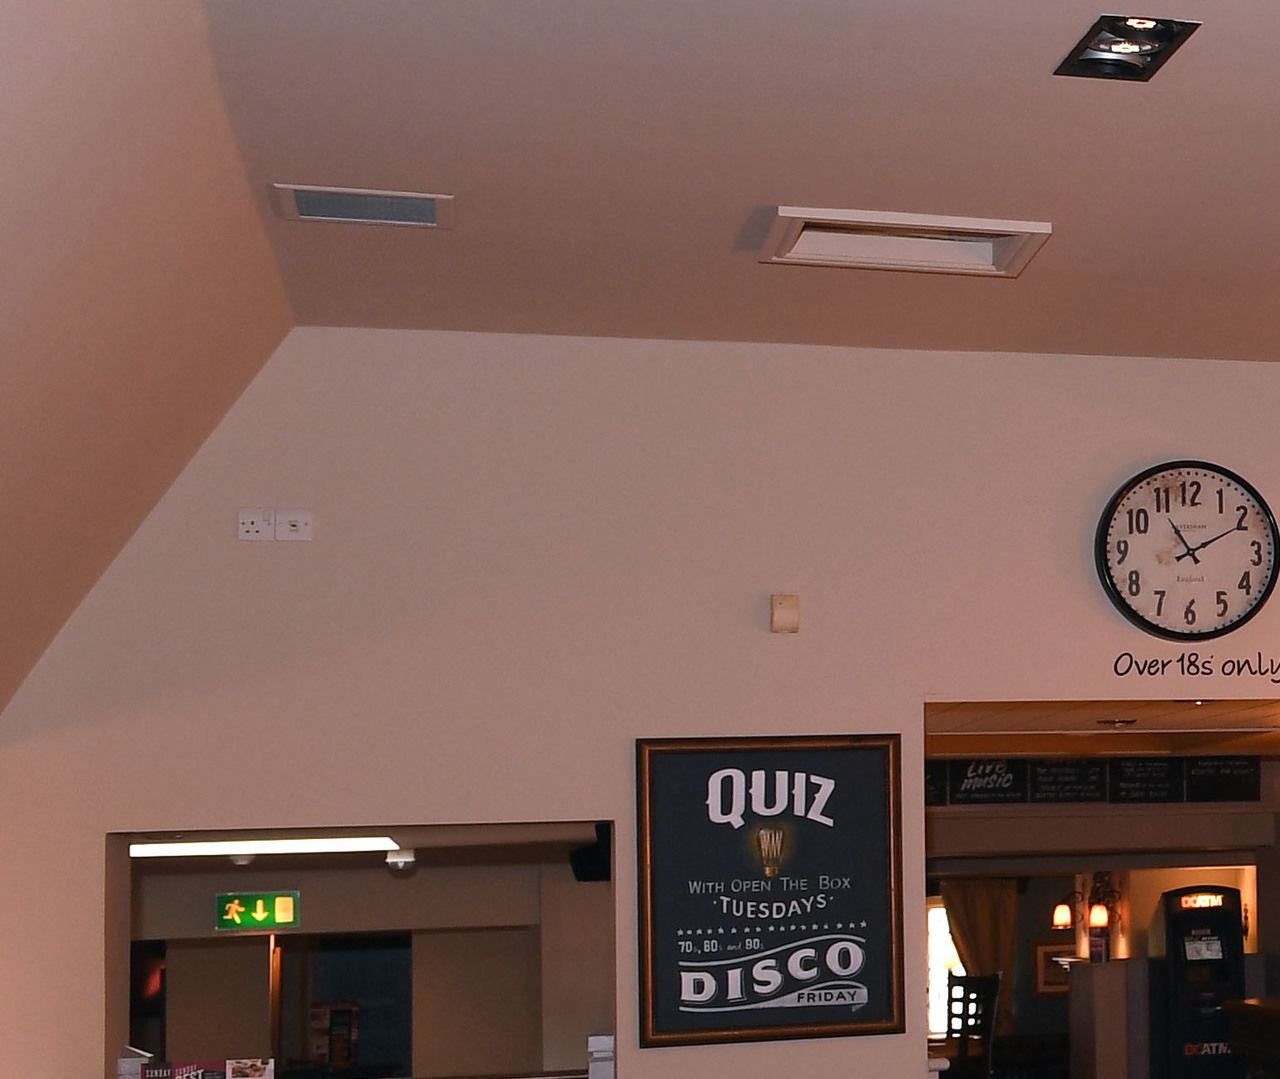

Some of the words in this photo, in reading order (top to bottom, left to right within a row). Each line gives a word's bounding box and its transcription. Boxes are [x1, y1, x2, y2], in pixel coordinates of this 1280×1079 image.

[1153, 486, 1170, 513] 11
[1180, 480, 1201, 507] 12
[1216, 487, 1224, 514] 1
[1127, 507, 1149, 535] 10
[1236, 505, 1248, 531] 2
[1116, 540, 1129, 565] 9
[1250, 540, 1262, 566] 3
[1128, 570, 1141, 597] 8
[1238, 570, 1252, 596] 4
[1154, 590, 1166, 617] 7
[1183, 598, 1196, 625] 6
[1216, 590, 1228, 617] 5
[1113, 652, 1172, 676] Over
[704, 767, 836, 830] QUIZ
[688, 880, 725, 894] WITH
[730, 878, 771, 893] OPEN
[779, 876, 808, 892] THE
[818, 875, 852, 890] BOX
[680, 941, 865, 1004] DISCO
[796, 990, 858, 1003] FRIDAY
